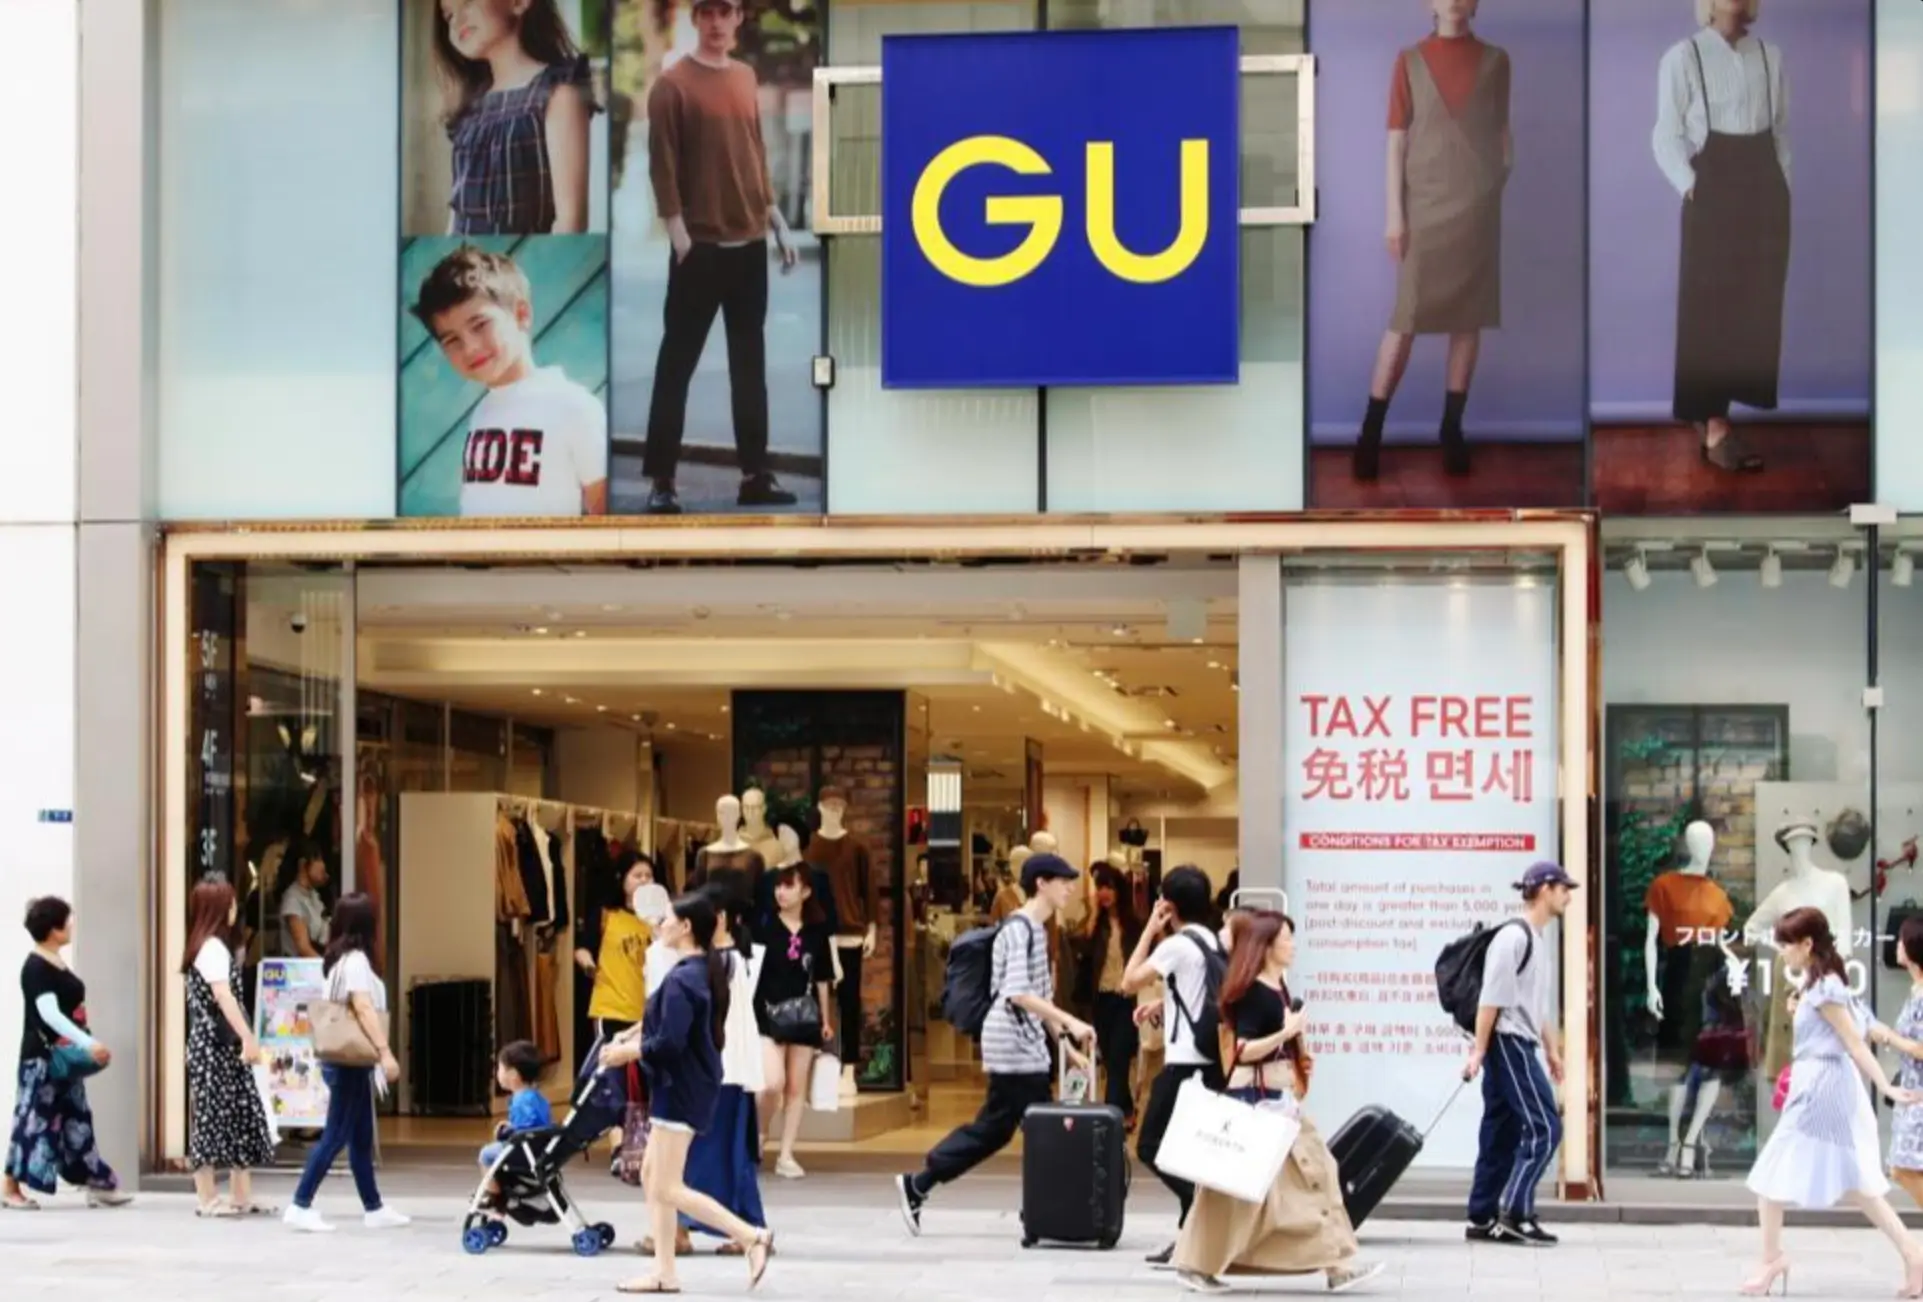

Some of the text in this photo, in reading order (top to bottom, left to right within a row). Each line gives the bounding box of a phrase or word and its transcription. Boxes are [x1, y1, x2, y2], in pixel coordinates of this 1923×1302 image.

[911, 134, 1209, 287] GU
[1300, 695, 1533, 737] TAX FREE
[1301, 747, 1533, 802] 免税 면세
[1309, 834, 1526, 849] CONDITIONS FOR TAX EXEMPTION
[1306, 879, 1336, 893] Total
[1341, 881, 1389, 893] amount
[1394, 881, 1406, 893] of
[1411, 881, 1475, 895] purchases
[1334, 900, 1358, 913] day
[1378, 900, 1424, 913] greater
[1430, 900, 1458, 911] than
[1463, 899, 1498, 913] 5,000
[1398, 919, 1424, 930] and
